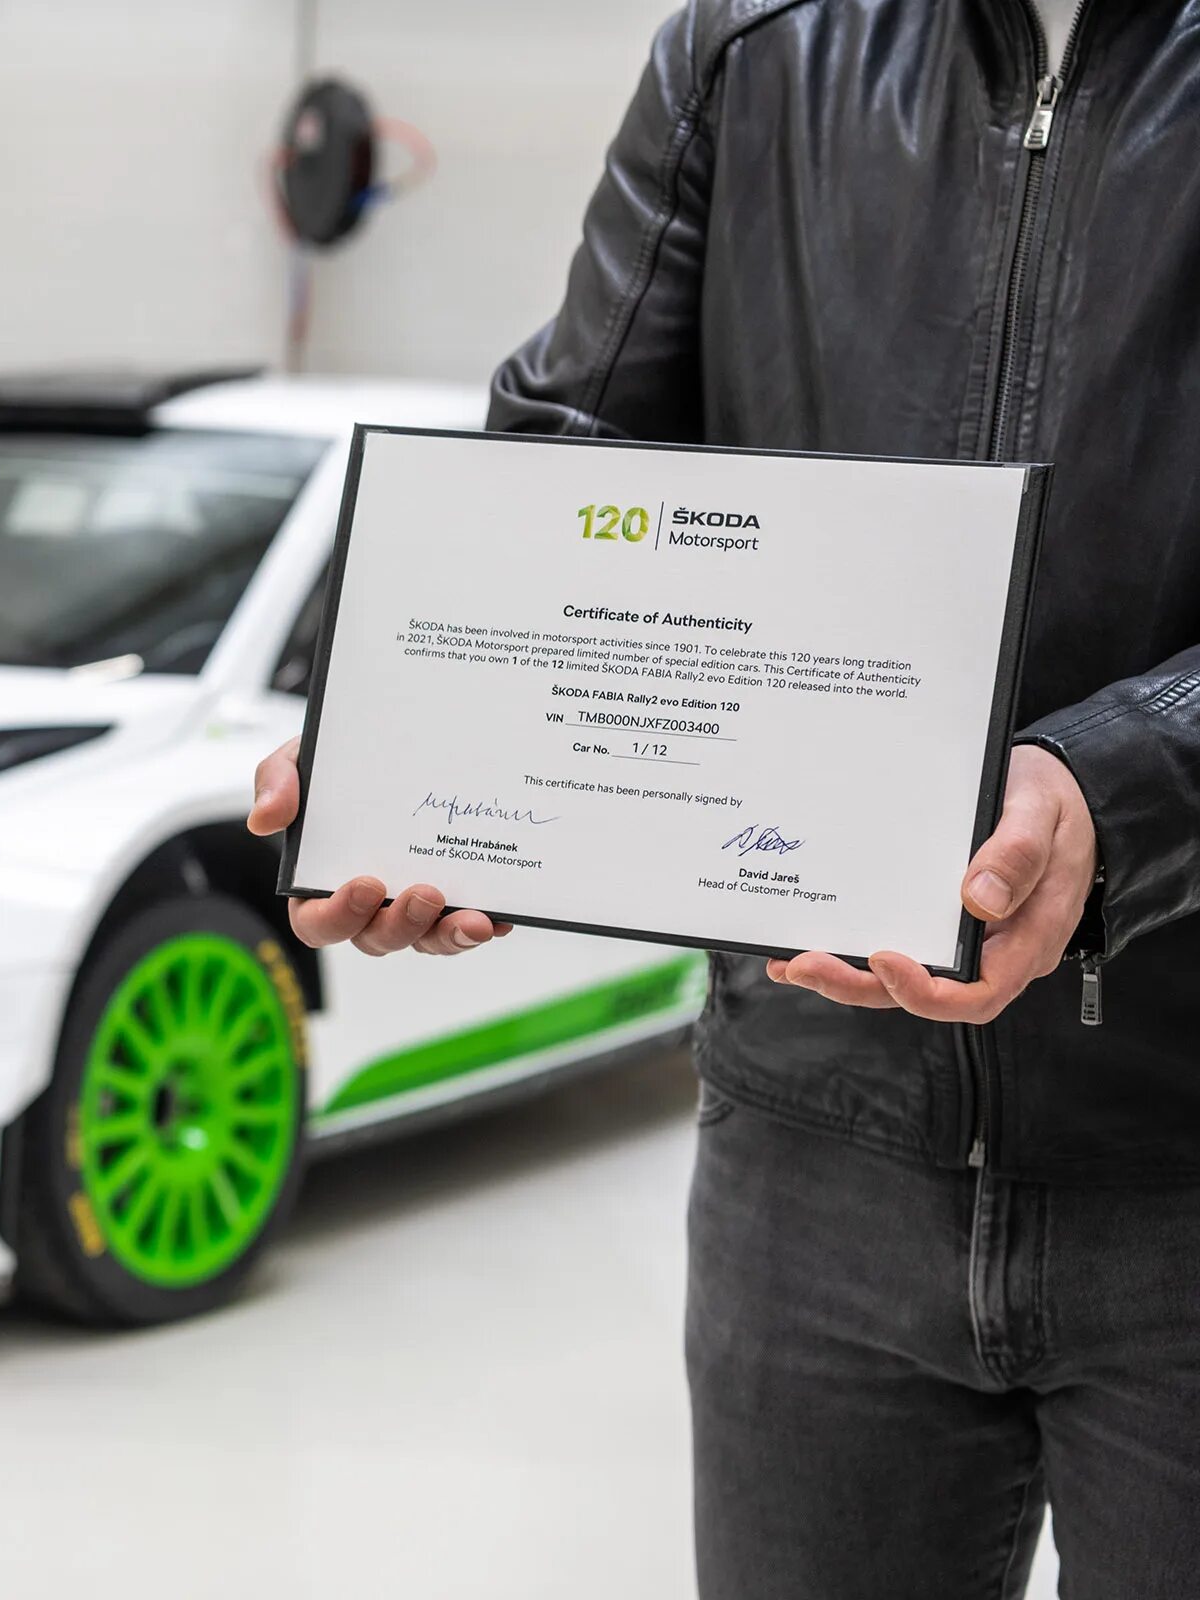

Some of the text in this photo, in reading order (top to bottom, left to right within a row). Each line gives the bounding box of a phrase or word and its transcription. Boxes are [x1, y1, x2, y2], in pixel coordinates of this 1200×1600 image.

[578, 504, 649, 542] 120
[671, 506, 761, 530] ŠKODA
[668, 530, 760, 552] Motorsport
[563, 604, 753, 635] Certificate of Authenticity
[408, 618, 912, 671] ŠKODA has been involved in motorsport activities since 1901. To celebrate this 120 years long tradition
[395, 632, 922, 688] in 2021, ŠKODA Motorsport prepared limited number of special edition cars. This Certificate of Authenticity
[404, 647, 446, 659] confirms
[447, 650, 467, 661] that
[469, 654, 487, 663] you
[488, 655, 509, 664] own
[519, 656, 531, 666] of
[532, 658, 549, 668] the
[551, 659, 565, 670] 12
[566, 660, 600, 673] limited
[601, 661, 639, 676] ŠKODA
[641, 667, 673, 679] FABIA
[674, 670, 705, 683] Rally2
[706, 675, 726, 684] evo
[727, 674, 763, 687] Edition
[766, 678, 787, 689] 120
[787, 680, 831, 693] released
[833, 683, 854, 695] into
[855, 685, 874, 696] the
[875, 688, 908, 699] world.
[551, 684, 740, 712] ŠKODA FABIA Rally2 evo Edition 120
[545, 710, 720, 735] VIN TMB000NJXFZ003400
[572, 742, 591, 753] Car
[593, 744, 610, 755] No.
[652, 744, 668, 757] 12
[524, 774, 743, 809] This certificate has been personally signed by
[436, 834, 518, 852] Michal Hrabánek
[408, 844, 543, 869] Head of ŠKODA Motorsport
[738, 867, 800, 884] David Jareš
[698, 877, 837, 903] Head of Customer Program
